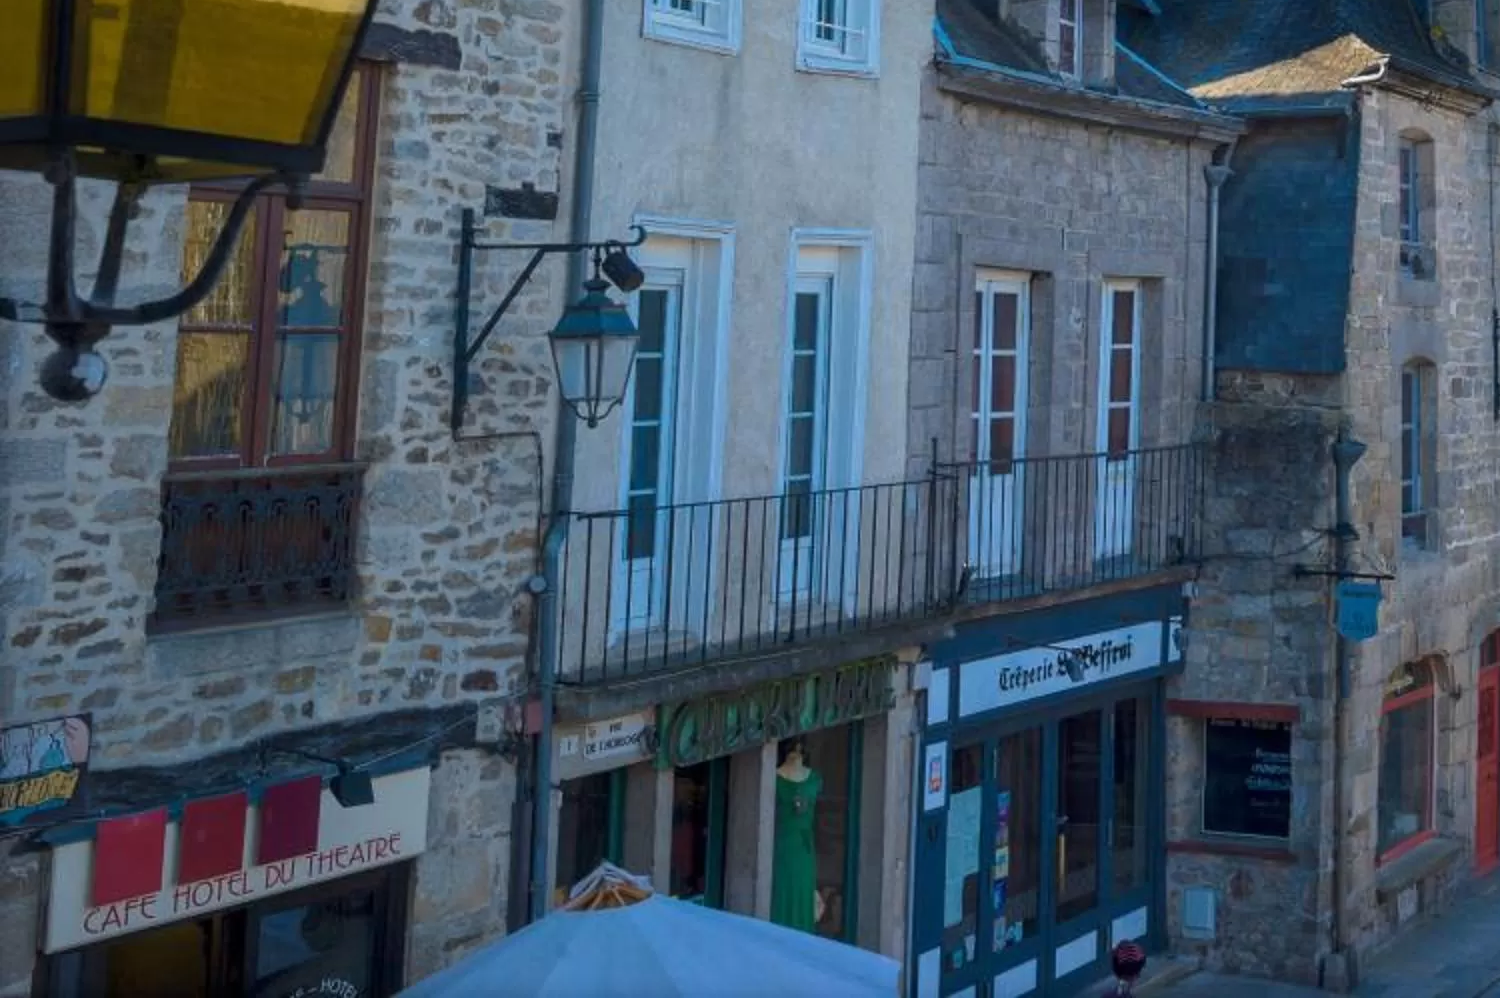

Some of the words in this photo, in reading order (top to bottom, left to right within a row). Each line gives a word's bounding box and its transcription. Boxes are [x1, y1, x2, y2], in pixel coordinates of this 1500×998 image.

[83, 896, 157, 935] CAFE
[173, 872, 254, 913] HOTEL
[265, 859, 295, 889] DU
[306, 832, 401, 878] THEATRE
